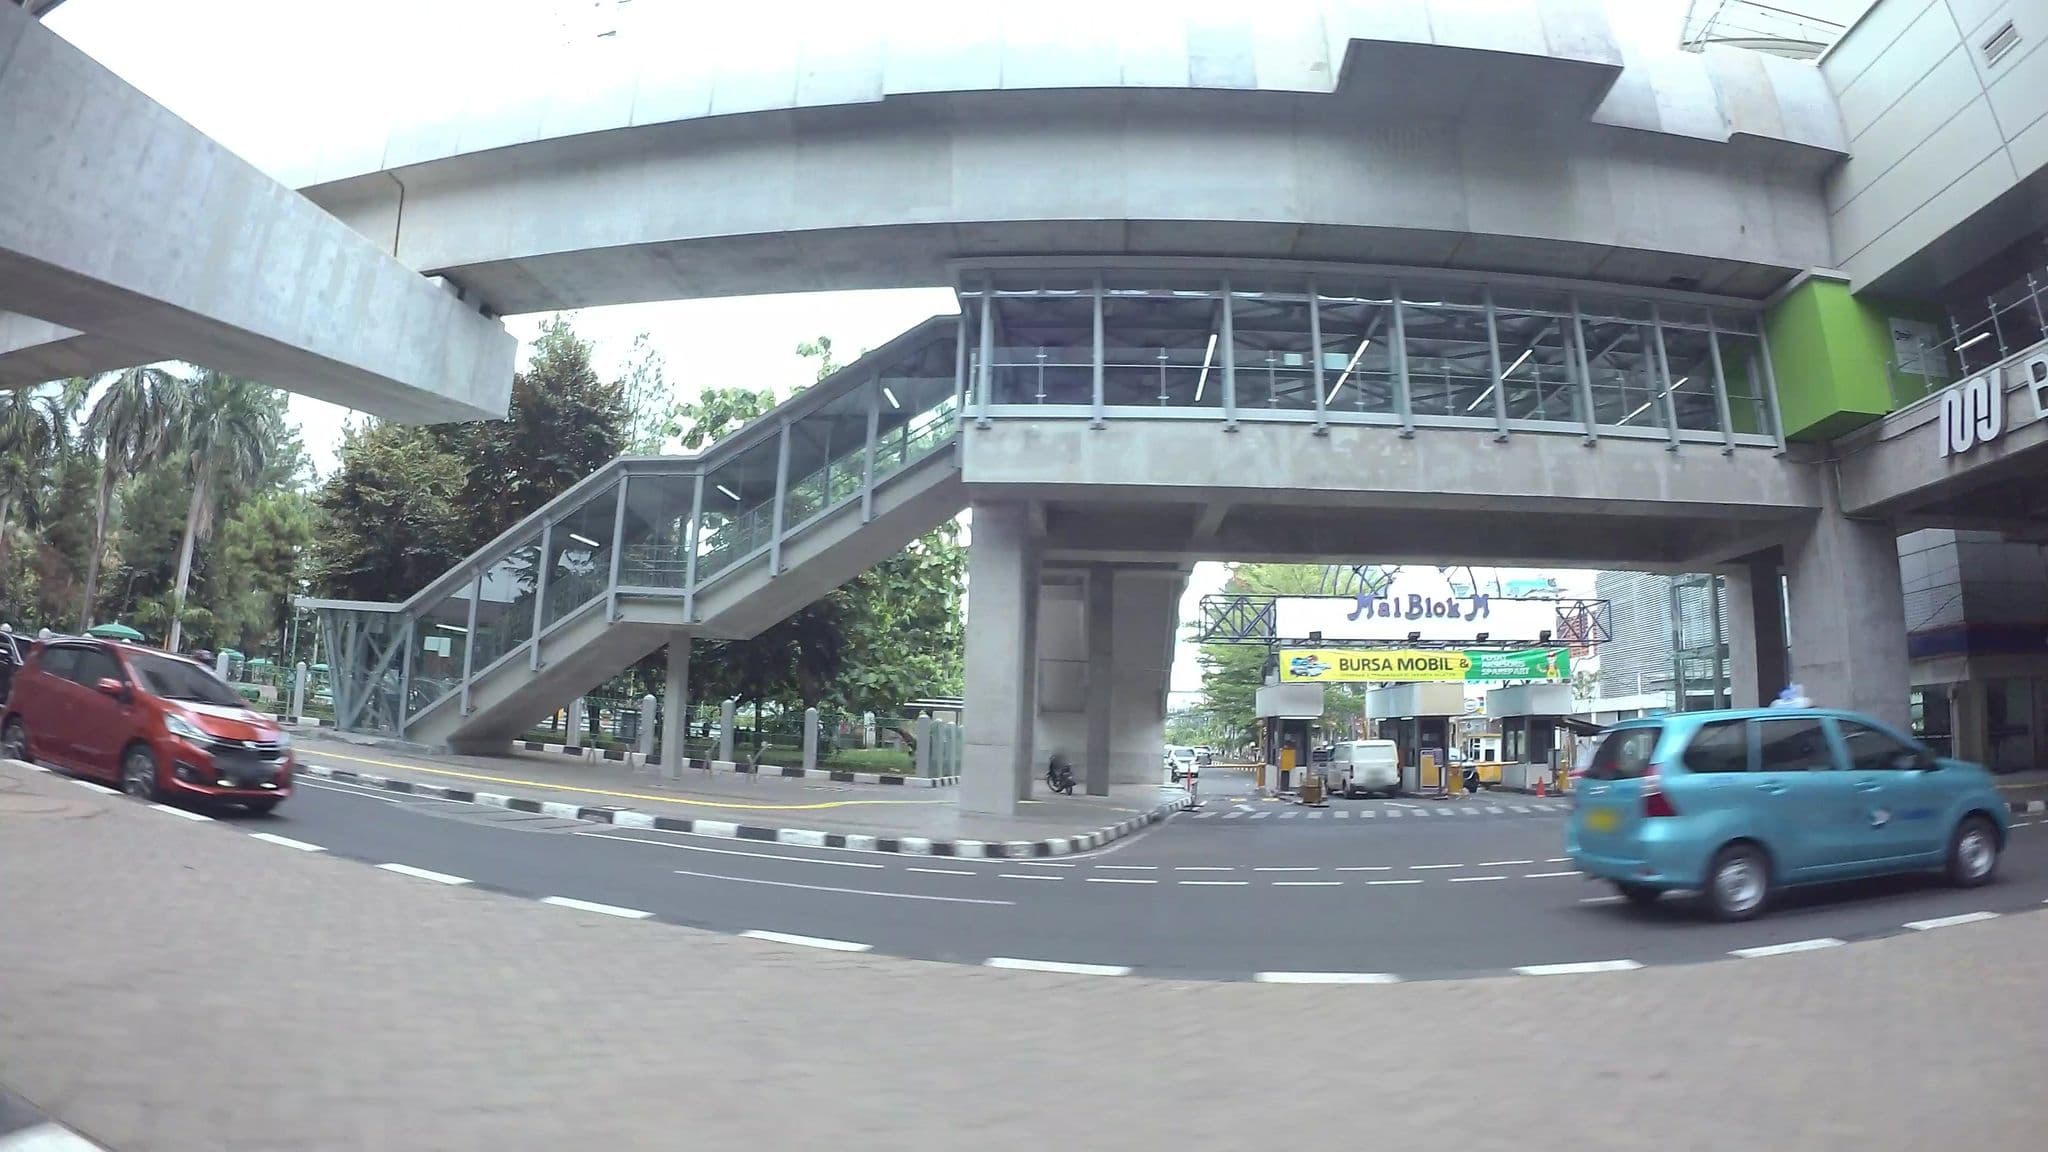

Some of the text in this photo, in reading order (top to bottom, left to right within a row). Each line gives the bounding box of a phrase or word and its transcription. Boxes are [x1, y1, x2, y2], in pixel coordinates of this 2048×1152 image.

[1347, 593, 1490, 621] Mal Blok M
[1339, 657, 1469, 671] BURSA MOBIL &
